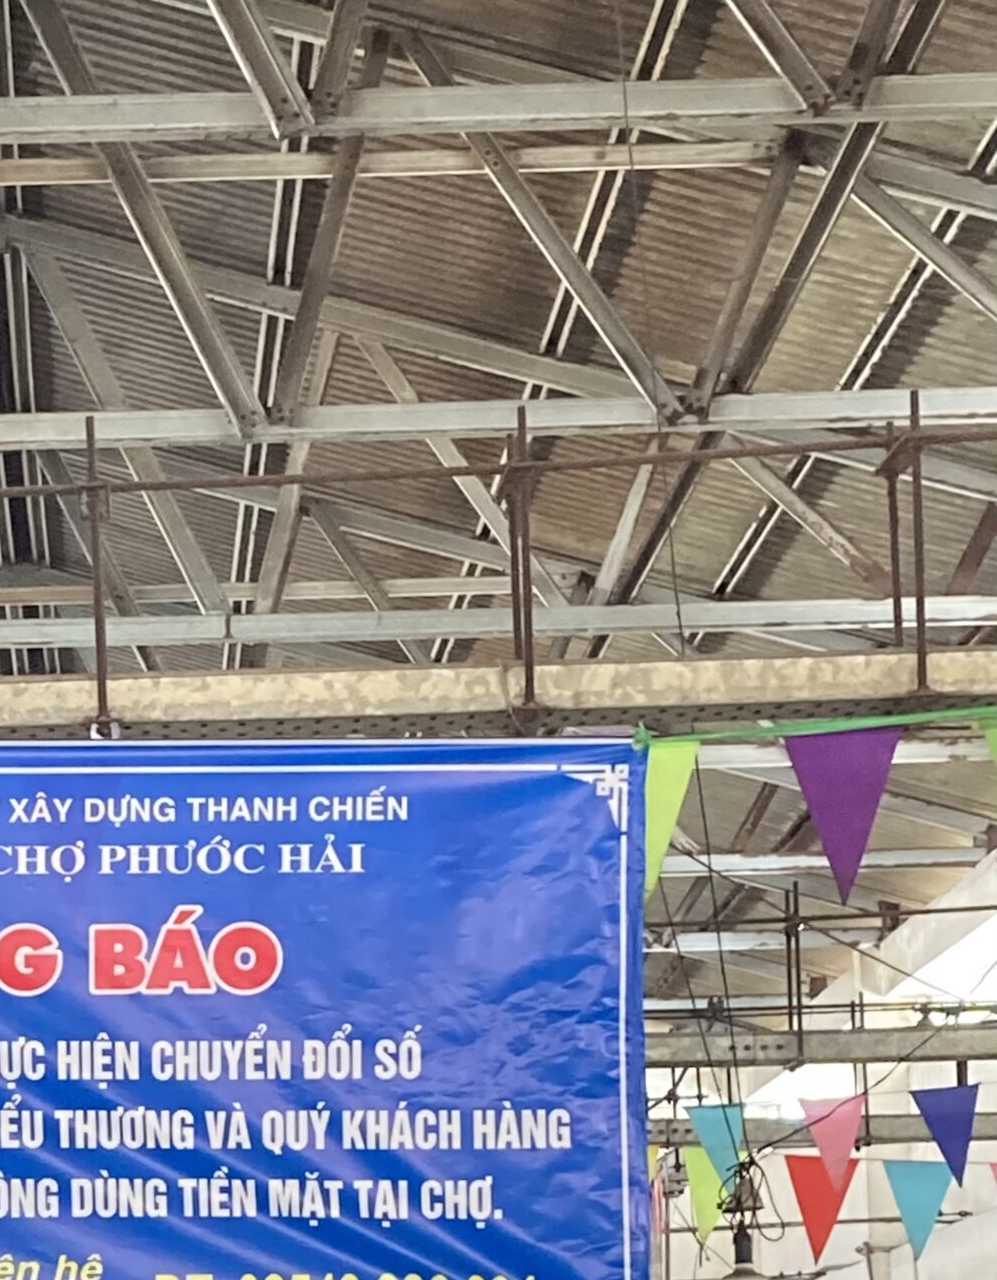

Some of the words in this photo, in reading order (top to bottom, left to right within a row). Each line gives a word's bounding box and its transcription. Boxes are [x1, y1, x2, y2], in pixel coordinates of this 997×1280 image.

[10, 792, 72, 822] XÂY
[85, 795, 175, 827] DỰNG
[187, 797, 297, 821] THANH
[309, 786, 407, 821] CHIẾN
[99, 835, 264, 874] PHƯỚC
[279, 833, 365, 873] HẢI
[89, 905, 283, 995] BÁO
[57, 1033, 139, 1089] HIỆN
[152, 1024, 291, 1080] CHUYỂN
[302, 1024, 362, 1079] ĐỔI
[375, 1025, 422, 1079] SỐ
[54, 1107, 194, 1149] THƯƠNG
[206, 1103, 250, 1149] VÀ
[262, 1102, 330, 1154] QUÝ
[343, 1102, 460, 1149] KHÁCH
[474, 1101, 571, 1149] HÀNG
[72, 1171, 168, 1217] DÙNG
[178, 1167, 258, 1217] TIỀN
[269, 1173, 342, 1226] MẶT
[353, 1180, 409, 1227] TẠI
[421, 1176, 504, 1228] CHỢ.
